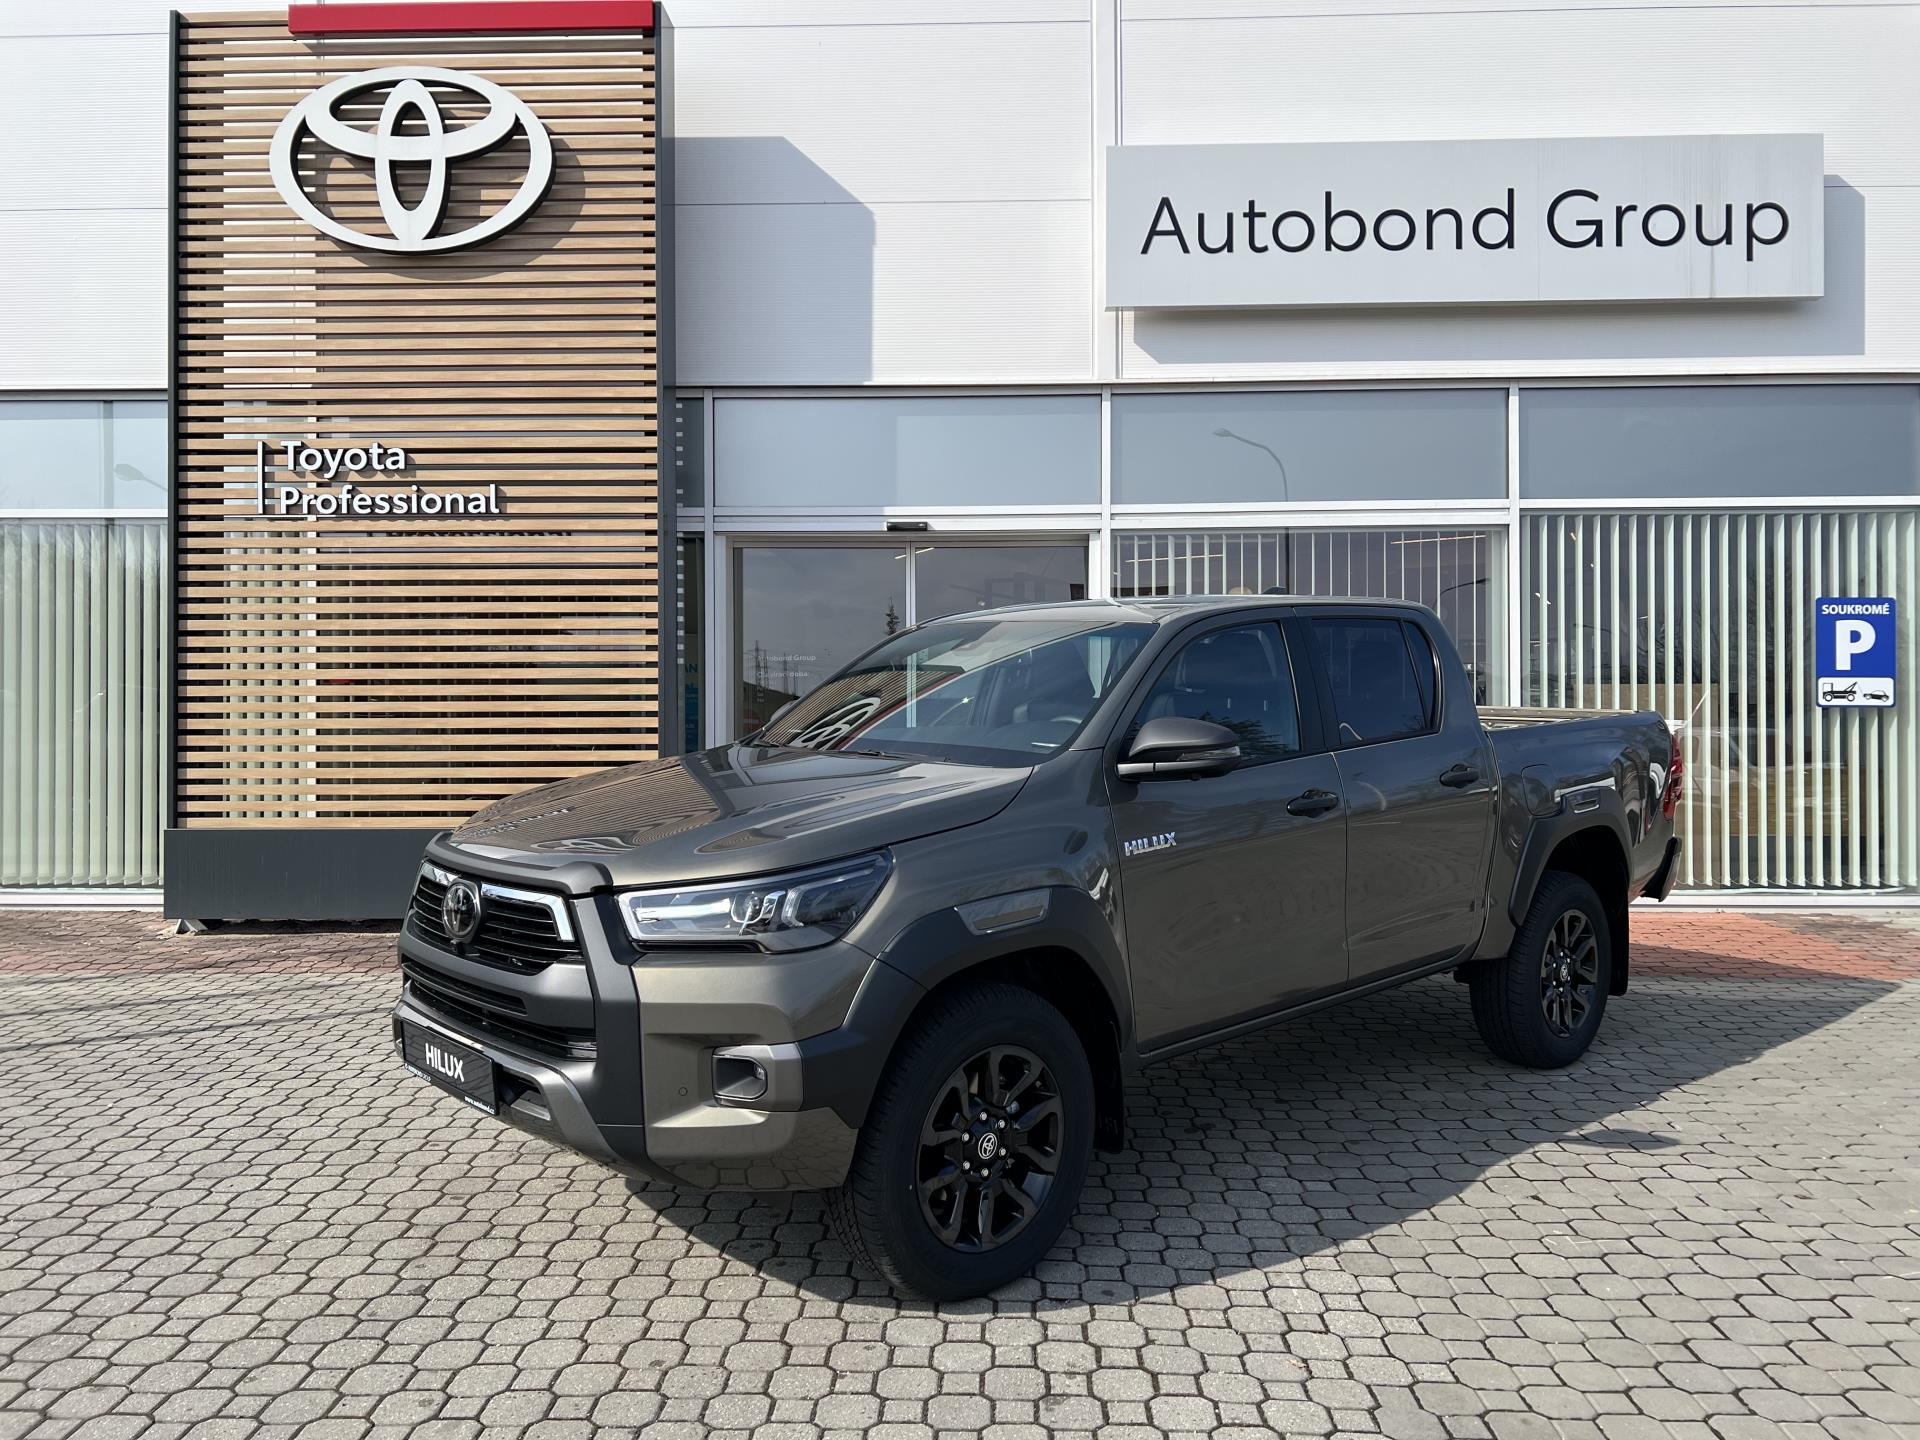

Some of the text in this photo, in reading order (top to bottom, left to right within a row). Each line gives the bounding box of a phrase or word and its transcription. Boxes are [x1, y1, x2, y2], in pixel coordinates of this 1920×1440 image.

[1140, 187, 1791, 262] Autobond Group
[280, 440, 406, 479] Toyota
[280, 483, 500, 514] Professional
[1822, 603, 1890, 615] SOUKROMÉ
[1835, 619, 1876, 671] P
[1124, 832, 1177, 856] HILUX
[425, 1043, 465, 1082] HILUX
